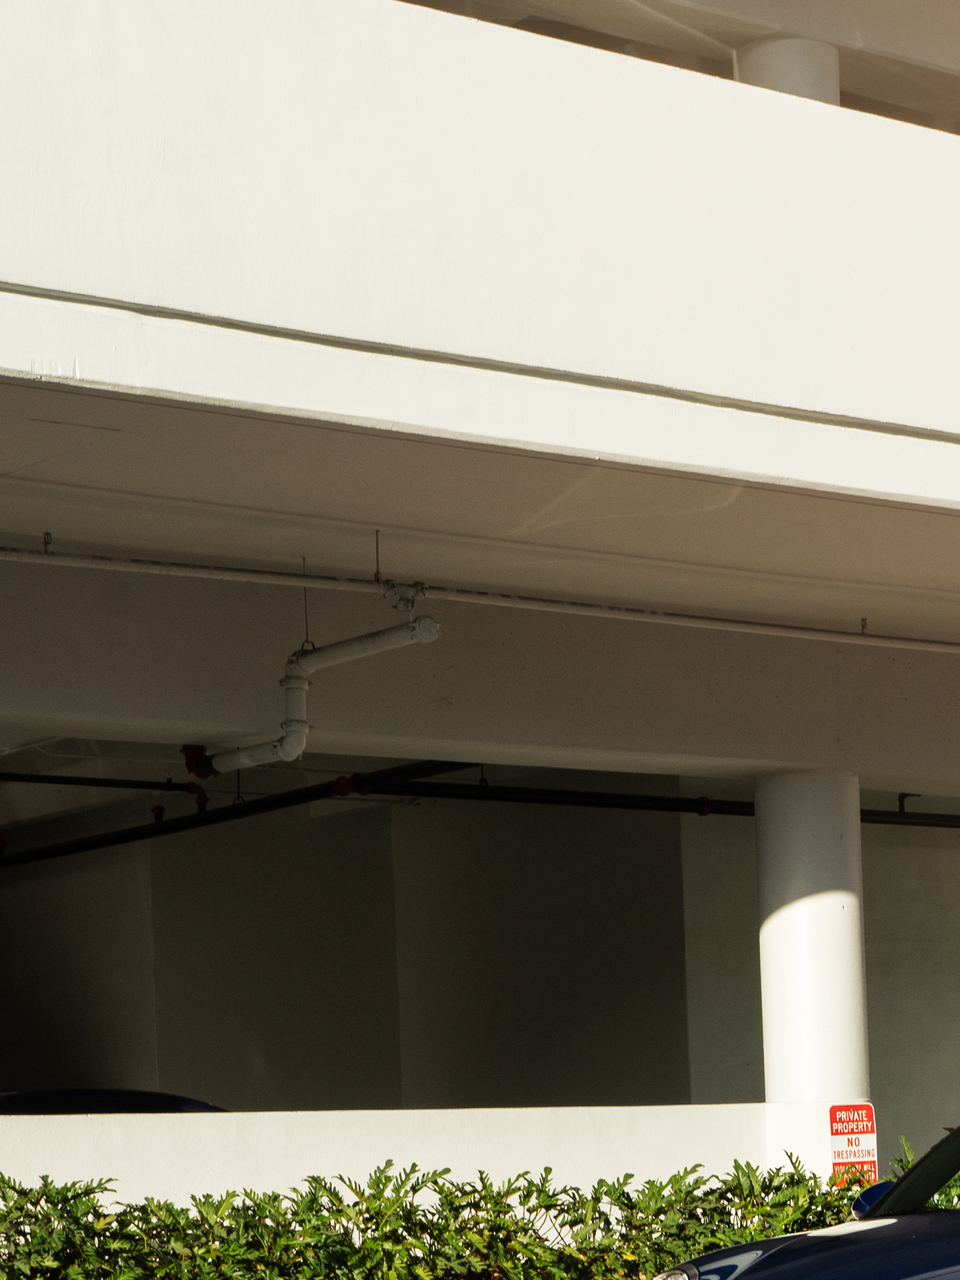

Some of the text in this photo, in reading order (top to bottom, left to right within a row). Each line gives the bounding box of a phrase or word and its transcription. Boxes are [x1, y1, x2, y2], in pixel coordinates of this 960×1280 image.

[836, 1110, 868, 1121] PRIVATE
[832, 1121, 872, 1133] PROPERTY
[847, 1137, 860, 1147] NO
[833, 1149, 875, 1159] TRESPASSING
